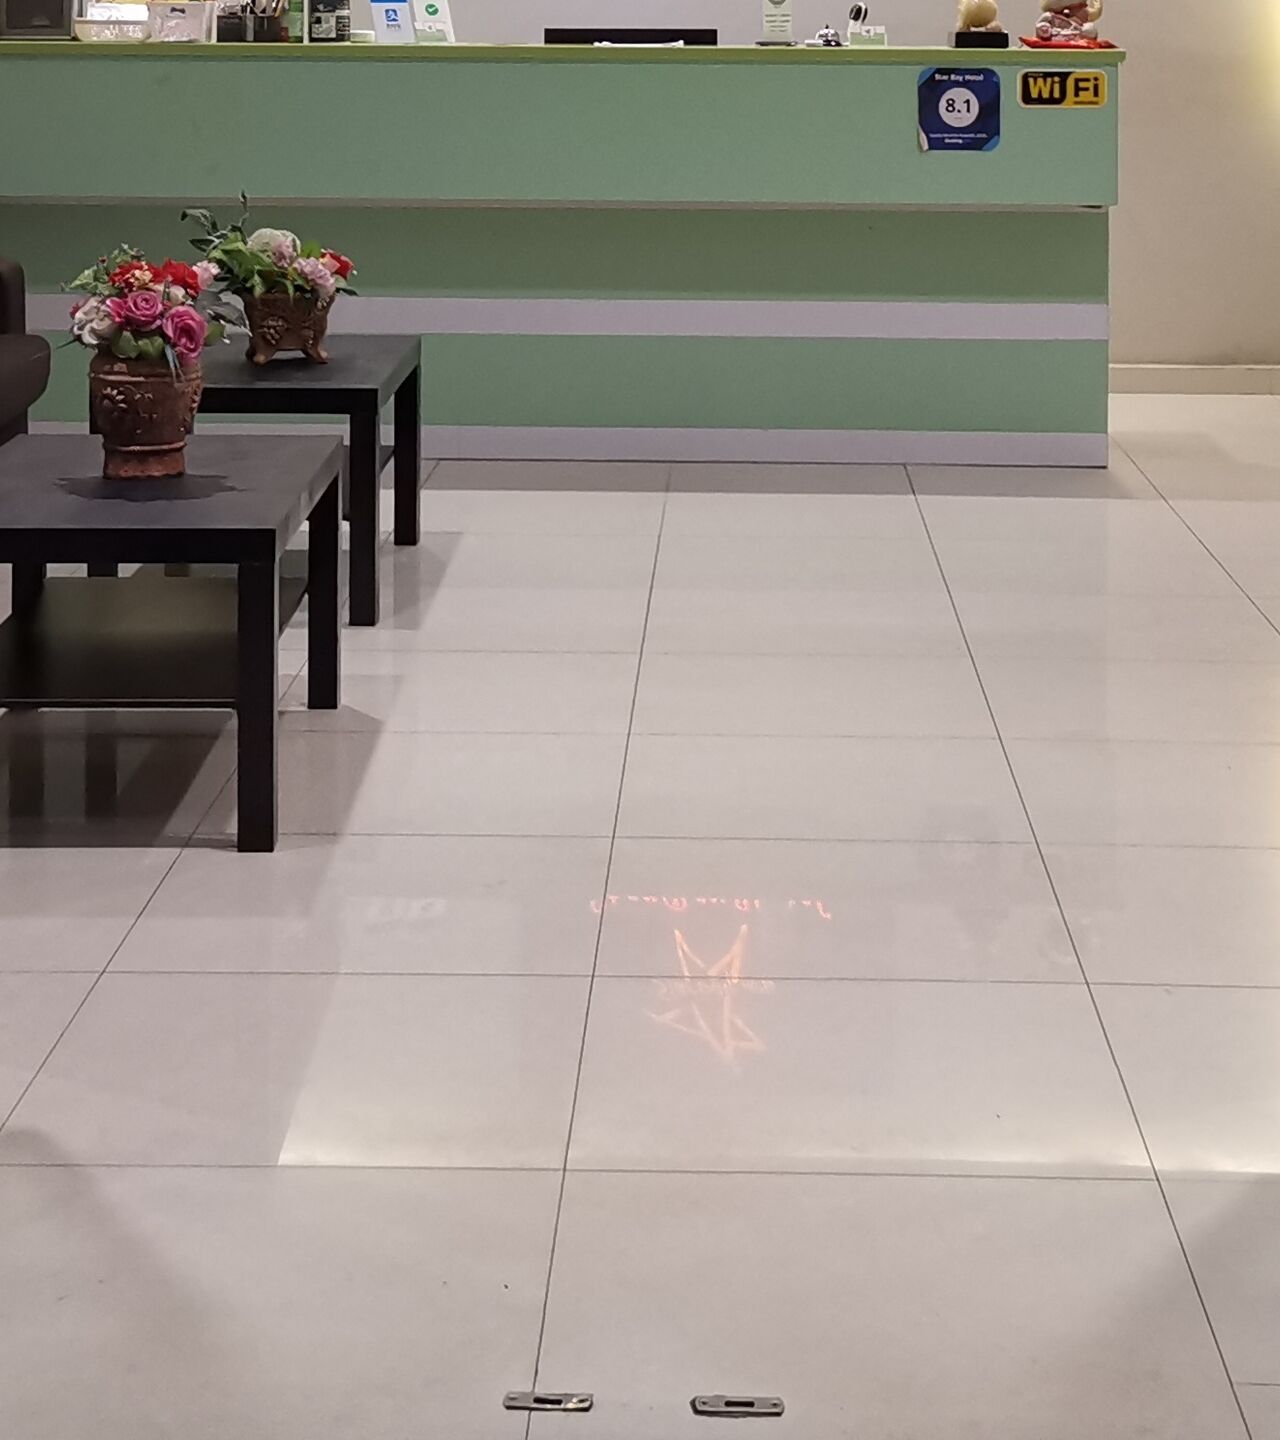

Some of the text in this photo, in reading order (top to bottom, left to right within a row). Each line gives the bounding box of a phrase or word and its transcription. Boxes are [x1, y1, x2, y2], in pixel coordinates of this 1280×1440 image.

[1027, 76, 1100, 98] Wi Fi
[945, 98, 971, 113] 8.1
